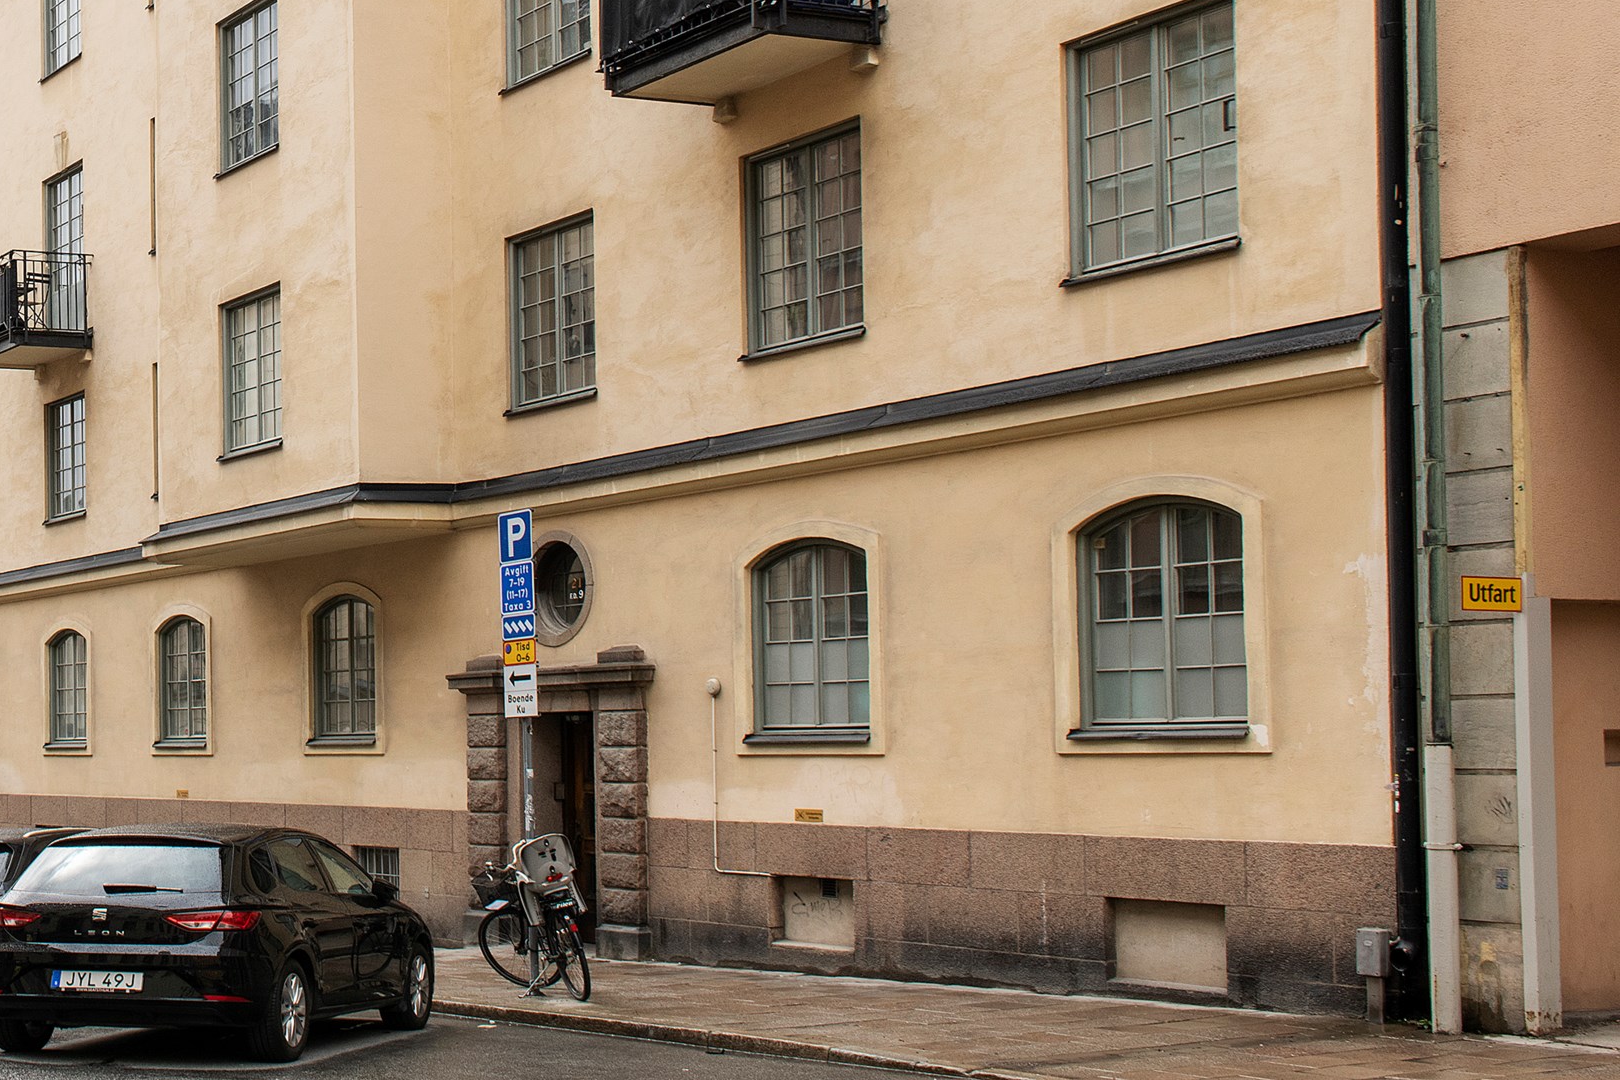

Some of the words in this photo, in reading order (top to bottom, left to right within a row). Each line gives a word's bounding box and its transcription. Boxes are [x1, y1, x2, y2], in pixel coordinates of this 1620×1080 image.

[507, 517, 526, 557] P
[504, 565, 529, 577] Avgift
[509, 577, 525, 587] 7-19
[506, 588, 528, 600] (11-17)
[578, 589, 584, 599] 9
[1469, 583, 1516, 603] Utfart
[504, 602, 524, 611] Taxa
[526, 600, 532, 609] 3
[516, 642, 530, 651] Tisd
[516, 653, 530, 662] 0-6
[508, 694, 534, 703] Boende
[516, 705, 526, 714] Ku
[66, 972, 96, 987] JYL
[102, 973, 135, 988] 49J
